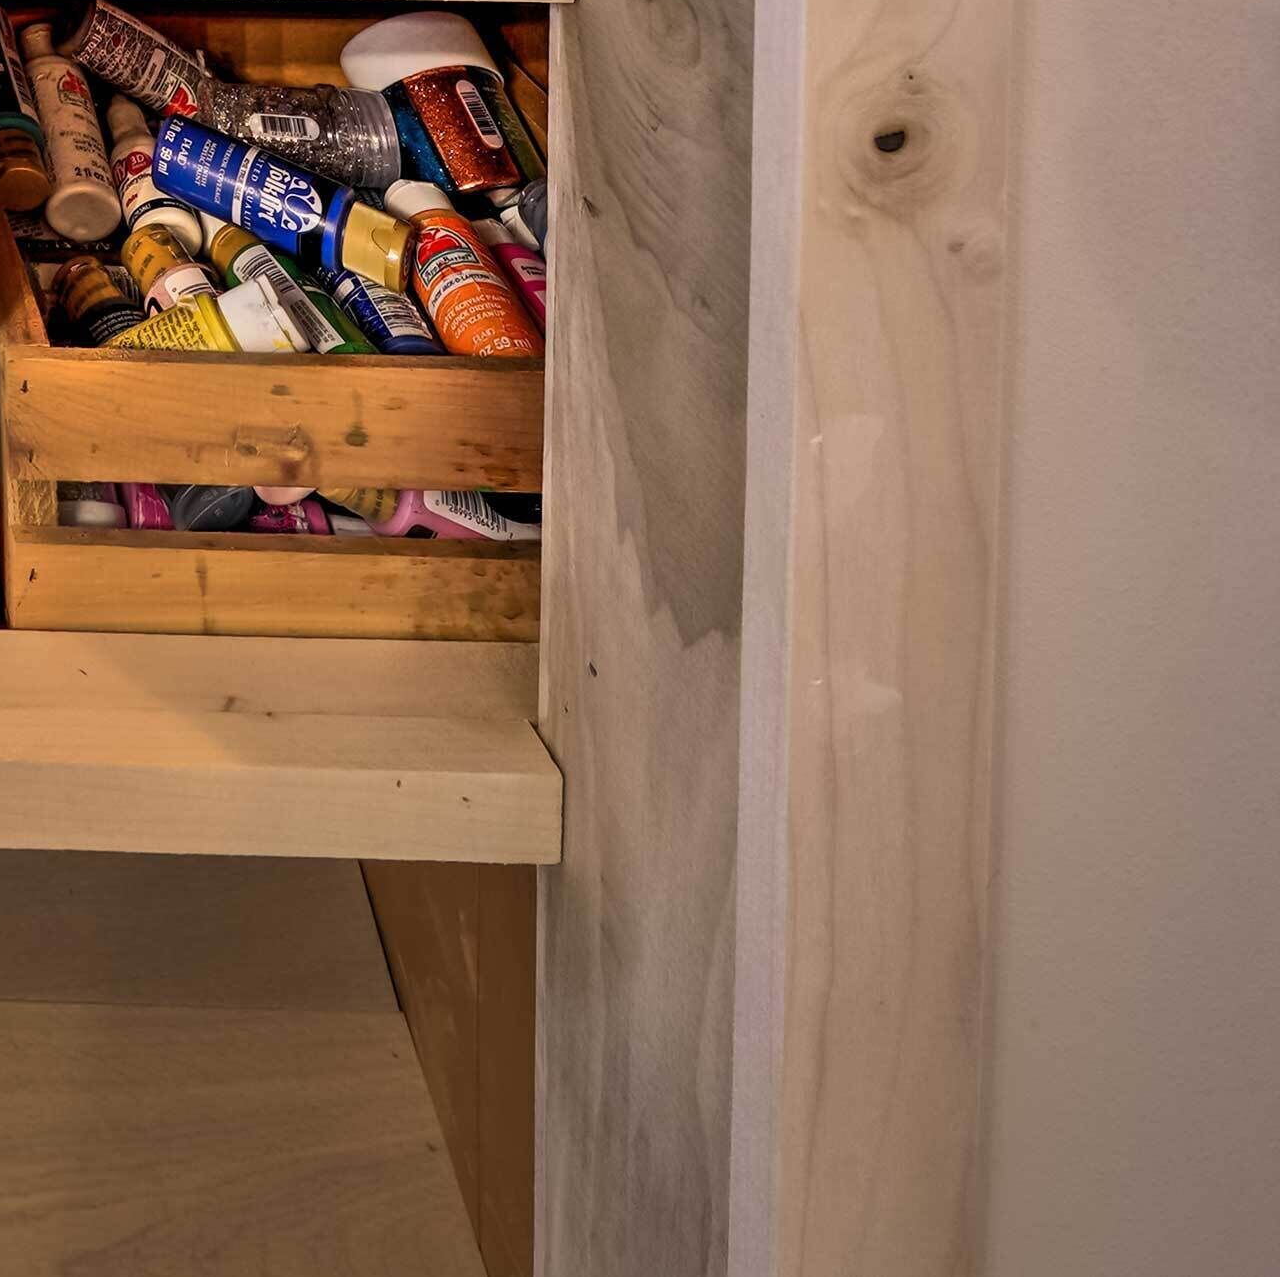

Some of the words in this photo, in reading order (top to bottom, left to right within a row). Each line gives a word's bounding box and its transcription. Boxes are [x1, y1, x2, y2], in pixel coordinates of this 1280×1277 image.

[164, 131, 176, 143] oz
[160, 146, 173, 161] 59
[176, 137, 193, 166] PLAID
[158, 160, 169, 176] ml
[493, 336, 511, 350] 59
